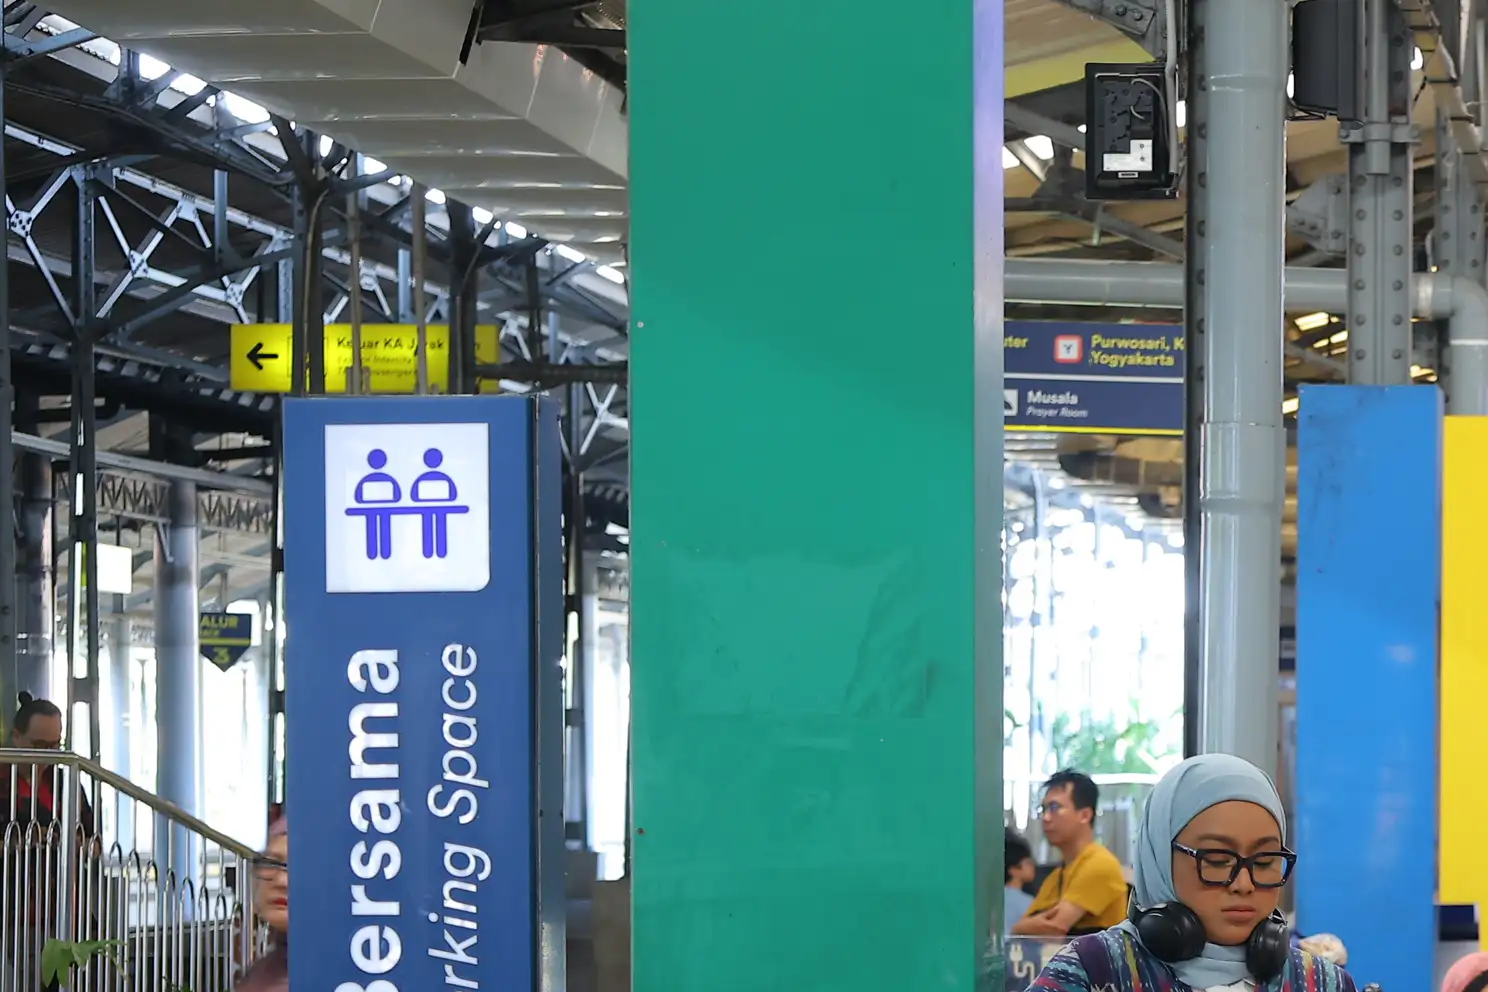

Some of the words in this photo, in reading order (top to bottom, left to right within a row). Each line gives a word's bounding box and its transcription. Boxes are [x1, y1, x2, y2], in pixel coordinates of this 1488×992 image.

[336, 337, 379, 349] Keuar
[383, 337, 403, 349] KA
[1091, 334, 1170, 352] Purwosari,
[1091, 351, 1175, 368] Yogyakarta
[1026, 390, 1079, 405] Musala
[1026, 406, 1058, 418] Prayer
[1059, 407, 1088, 418] Room
[212, 647, 231, 664] 3
[427, 642, 490, 825] Space
